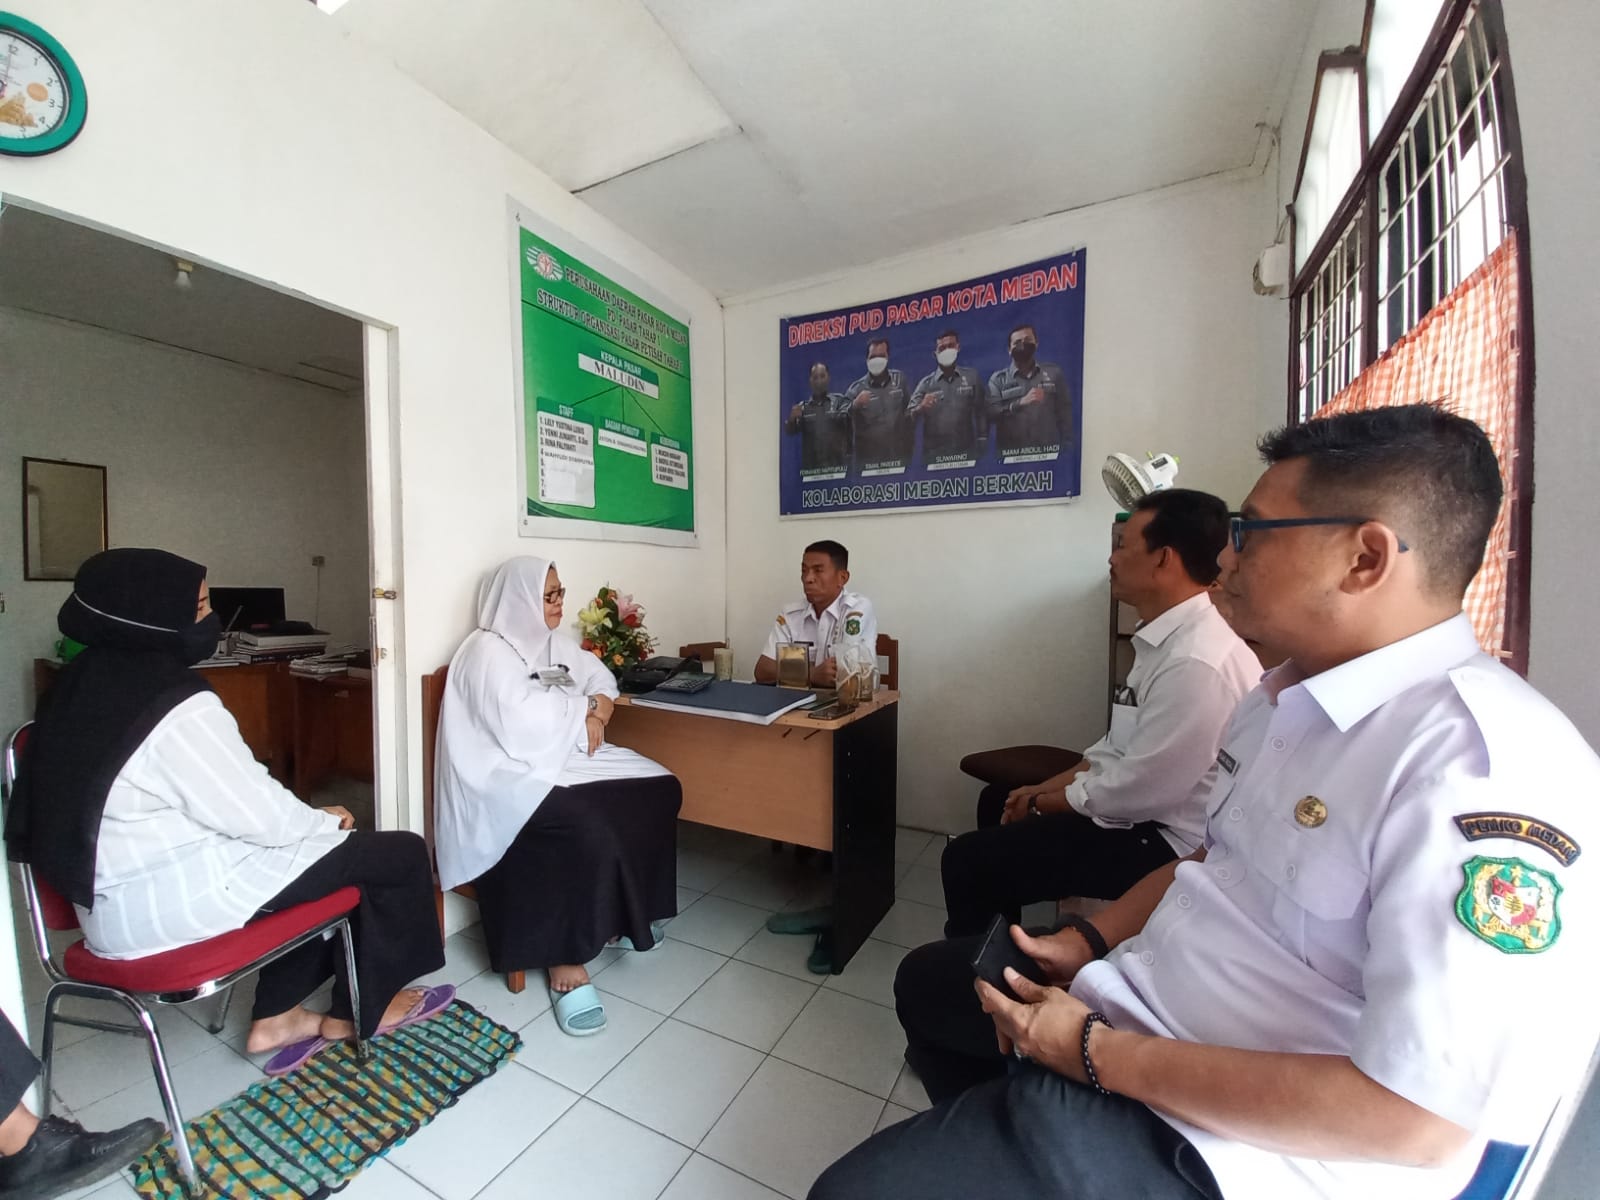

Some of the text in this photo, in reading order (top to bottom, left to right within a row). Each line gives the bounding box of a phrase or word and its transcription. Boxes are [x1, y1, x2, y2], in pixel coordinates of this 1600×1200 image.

[565, 266, 610, 303] PERUSAHAAN
[611, 293, 636, 316] DAERAH
[637, 307, 655, 329] PASAR
[788, 262, 1078, 348] DIREKSI PUD PASAR KOTA MEDAN
[537, 288, 579, 321] STRUKTUR
[580, 310, 620, 341] ORGANISASI
[621, 330, 639, 351] PASAR
[619, 313, 637, 333] PASAR
[594, 360, 645, 393] MALUDIN
[600, 350, 642, 377] KEPALA PASAR
[802, 470, 1053, 508] KOLABORASI MEDAN BERKAH
[1464, 818, 1579, 861] PEMKO MEDAN
